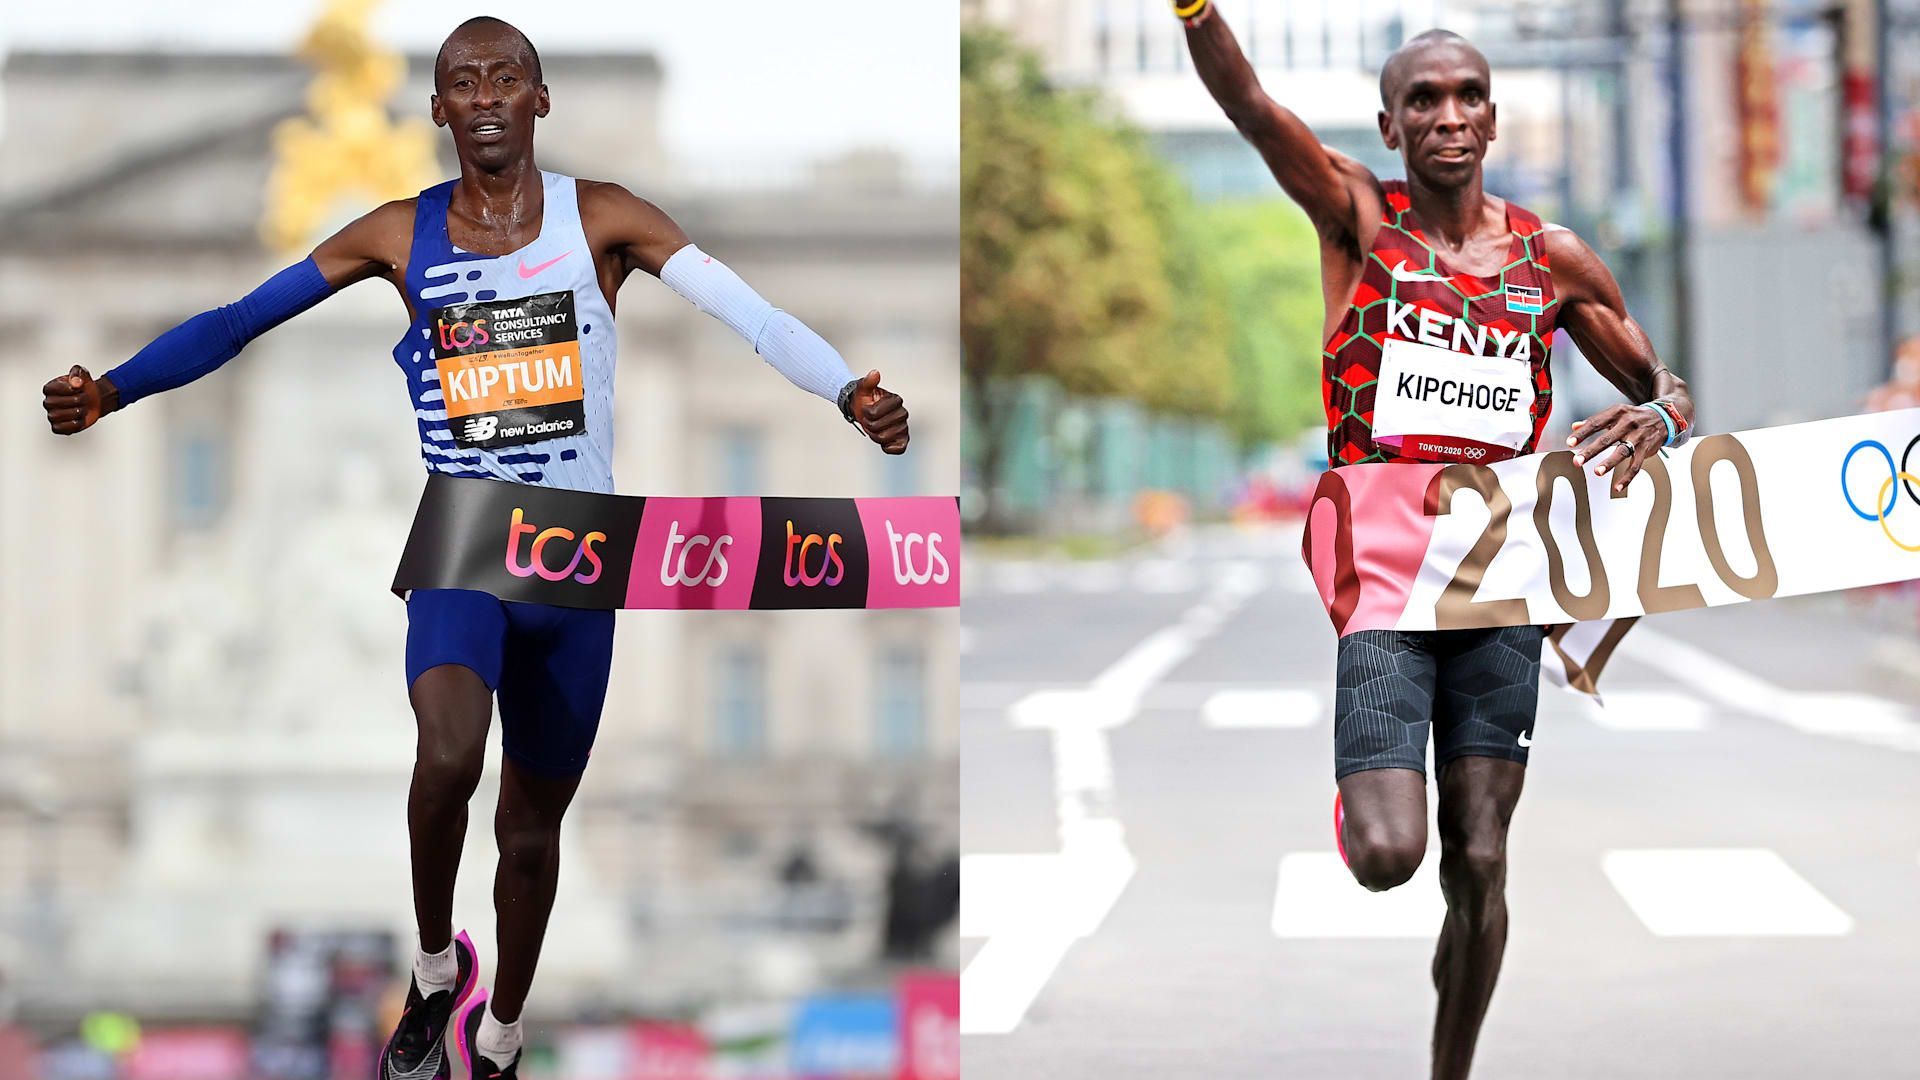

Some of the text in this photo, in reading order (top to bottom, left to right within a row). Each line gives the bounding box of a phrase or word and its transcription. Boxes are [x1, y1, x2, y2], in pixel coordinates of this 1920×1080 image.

[437, 318, 490, 350] tcs
[492, 308, 525, 320] TATA
[493, 312, 567, 332] CONSULTANCY
[495, 328, 543, 343] SERVICES
[1387, 299, 1531, 361] KENYA
[447, 355, 573, 403] KIPTUM
[1396, 372, 1521, 412] KIPCHOGE
[500, 419, 573, 438] new balance
[1418, 442, 1462, 455] TOKYO 2020
[505, 508, 607, 585] tcs
[660, 520, 733, 587] tcs
[783, 520, 843, 587] tcs
[885, 519, 950, 585] tcs
[1423, 433, 1779, 630] 2020
